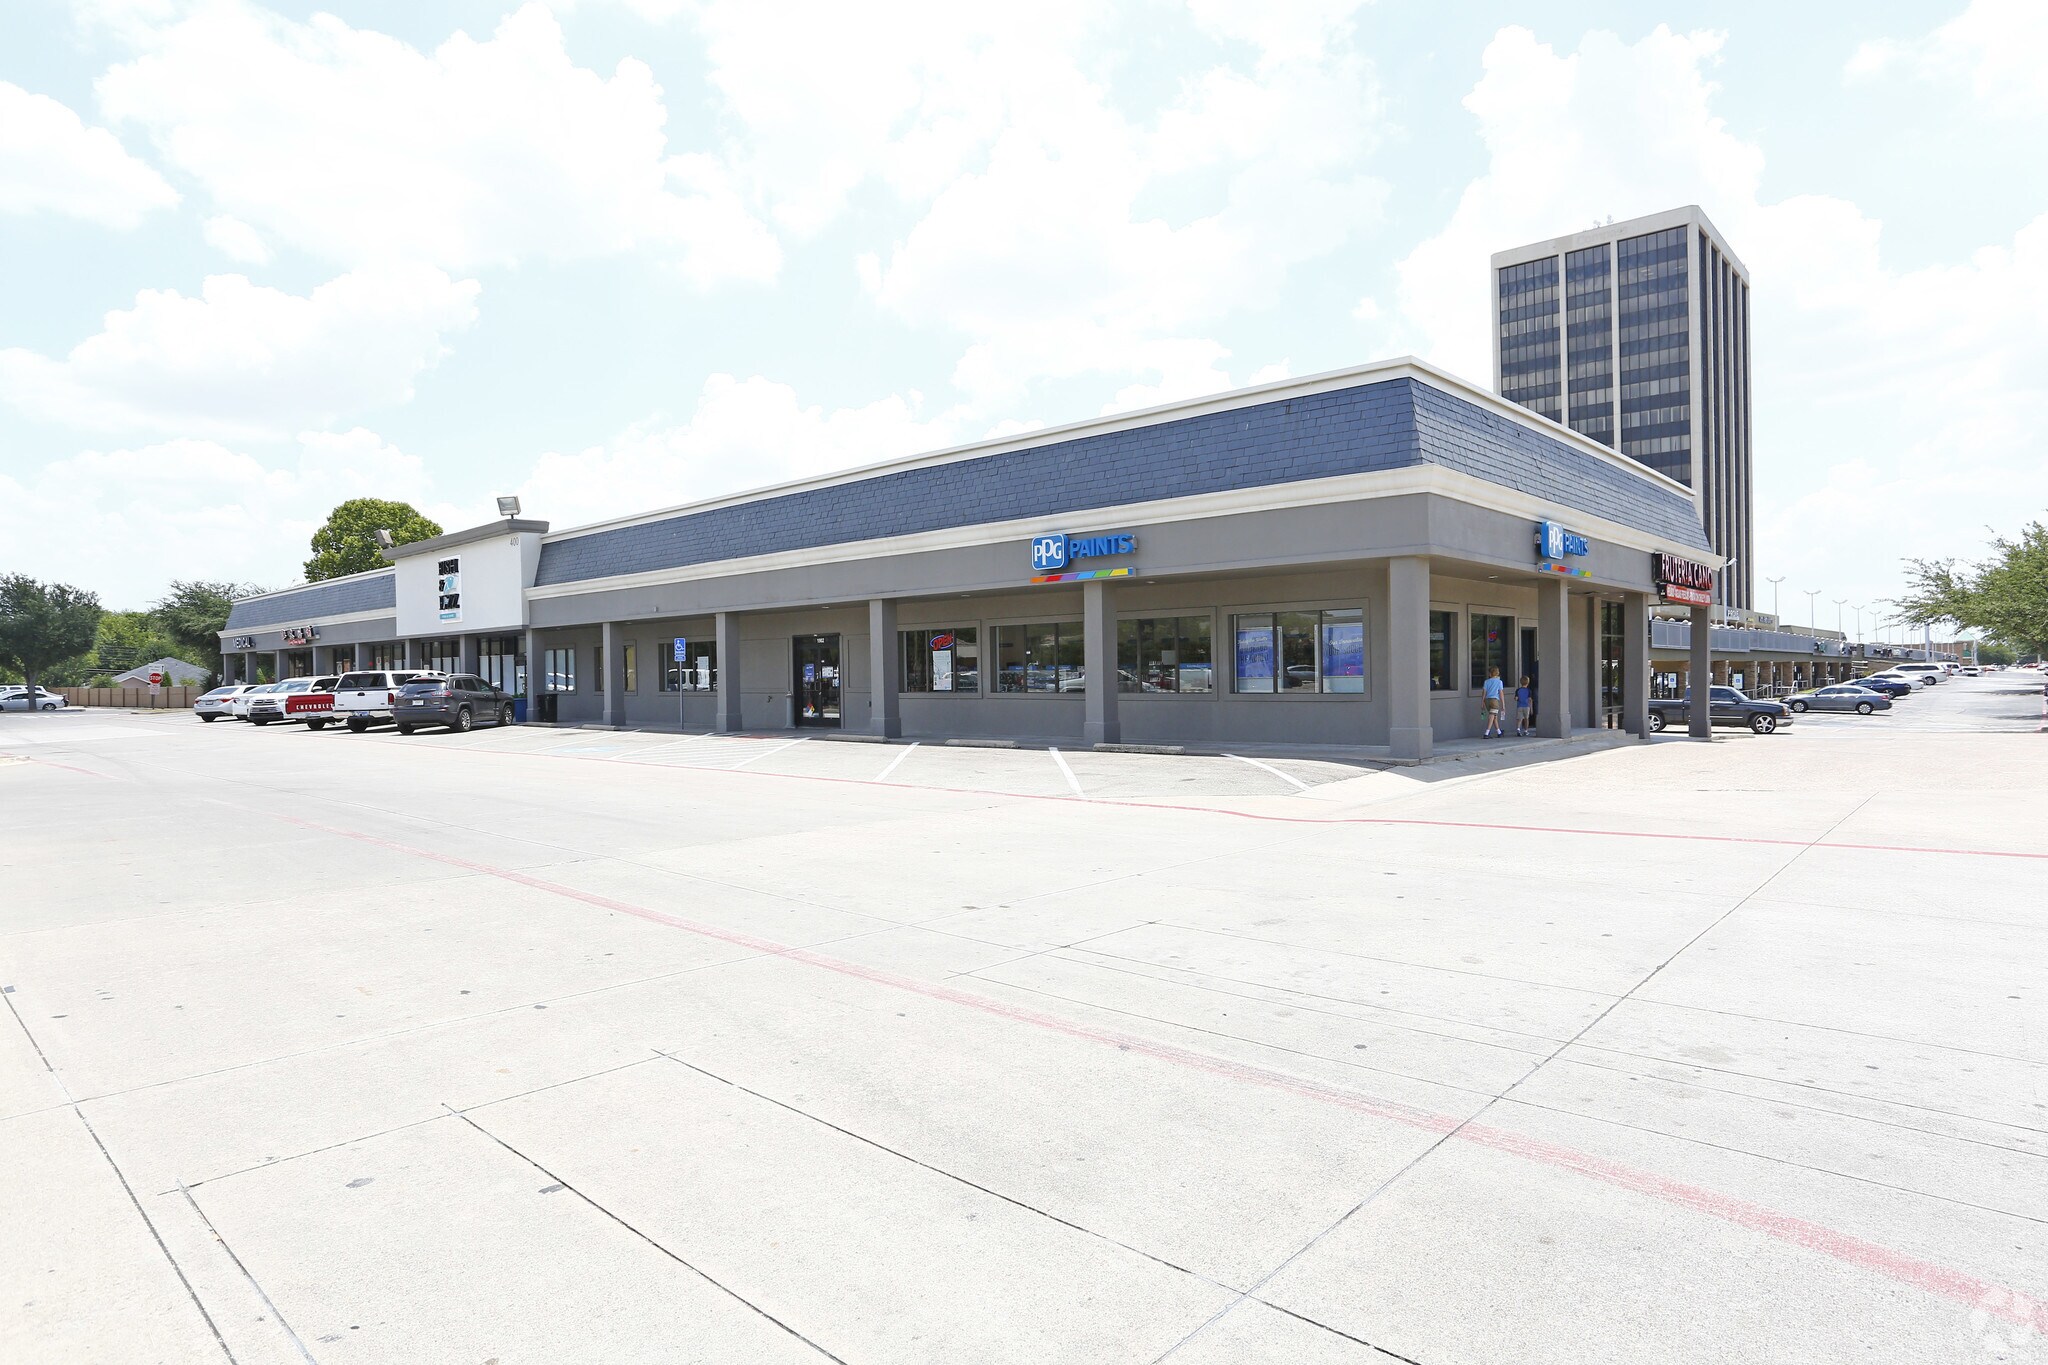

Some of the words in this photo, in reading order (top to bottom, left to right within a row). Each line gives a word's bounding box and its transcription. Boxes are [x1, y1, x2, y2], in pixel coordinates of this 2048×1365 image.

[1033, 539, 1063, 567] PPG
[1069, 534, 1134, 559] PAINTS
[1550, 526, 1563, 554] PPG
[1563, 533, 1588, 556] PAINTS
[1661, 553, 1693, 586] FRUTERIA
[1694, 563, 1712, 590] CANO
[933, 634, 953, 650] OPEN
